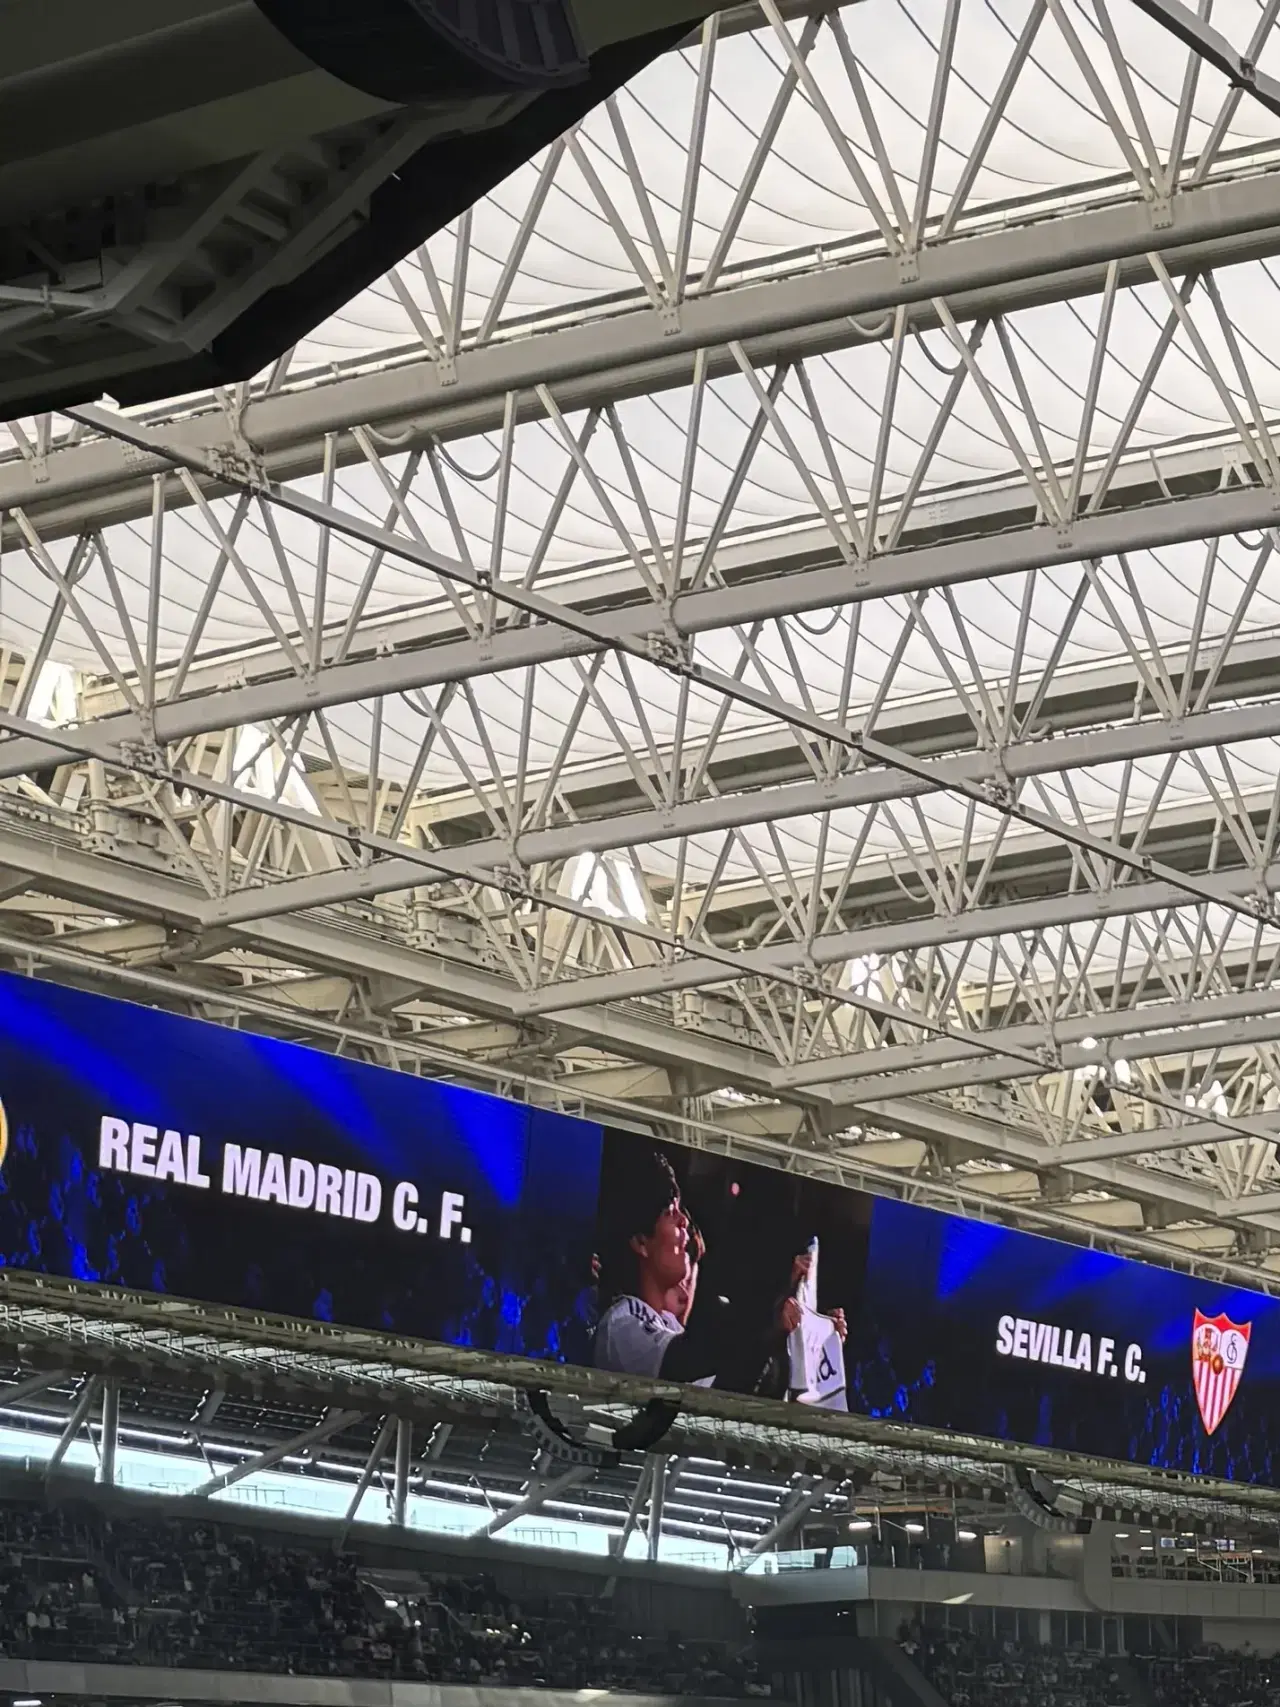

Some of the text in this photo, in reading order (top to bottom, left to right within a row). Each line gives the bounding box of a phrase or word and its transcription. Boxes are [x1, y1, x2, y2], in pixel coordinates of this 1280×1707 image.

[100, 1115, 473, 1243] REAL MADRID C. F.
[996, 1314, 1147, 1384] SEVILLA F. C.
